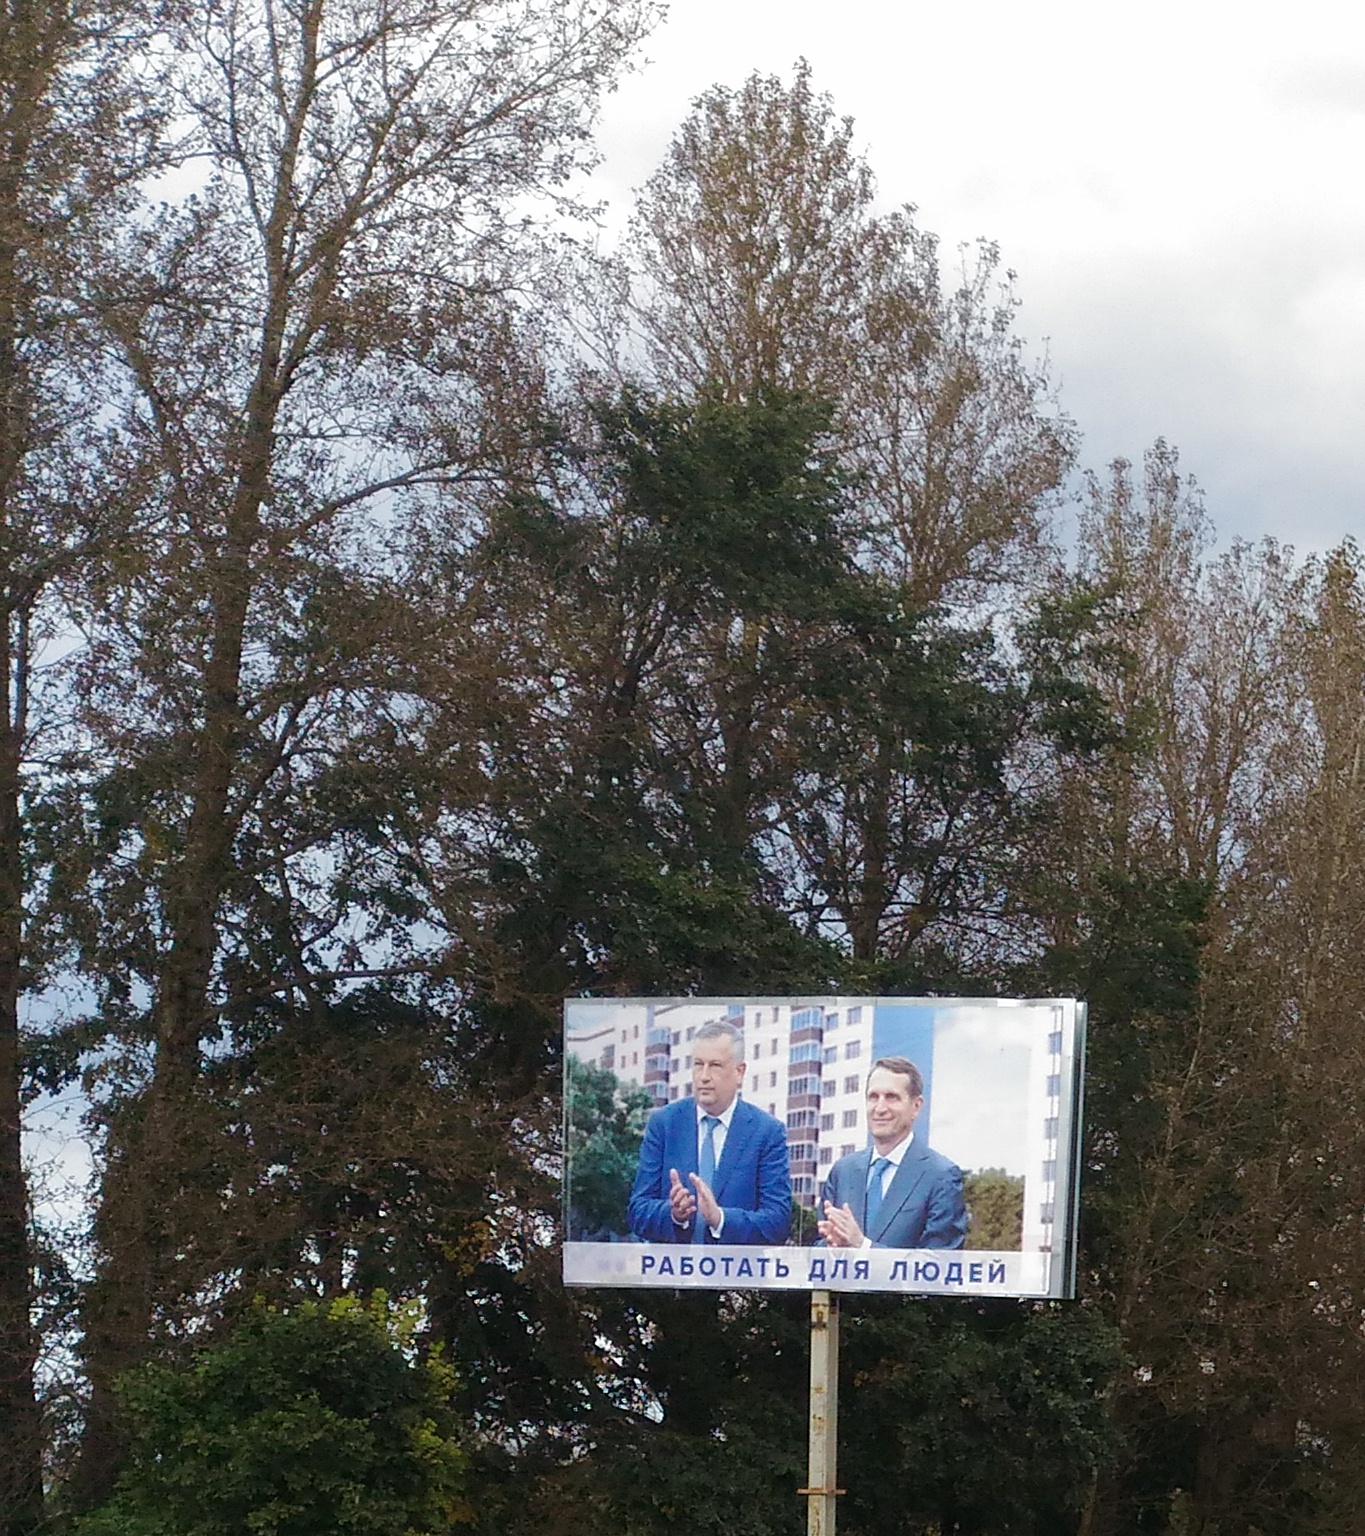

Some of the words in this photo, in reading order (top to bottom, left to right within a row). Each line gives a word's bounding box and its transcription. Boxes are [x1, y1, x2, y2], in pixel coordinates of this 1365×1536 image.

[640, 1255, 790, 1278] РАБОТАТЬ
[808, 1258, 869, 1282] ДЛЯ
[889, 1258, 1006, 1285] ЛЮДЕЙ
